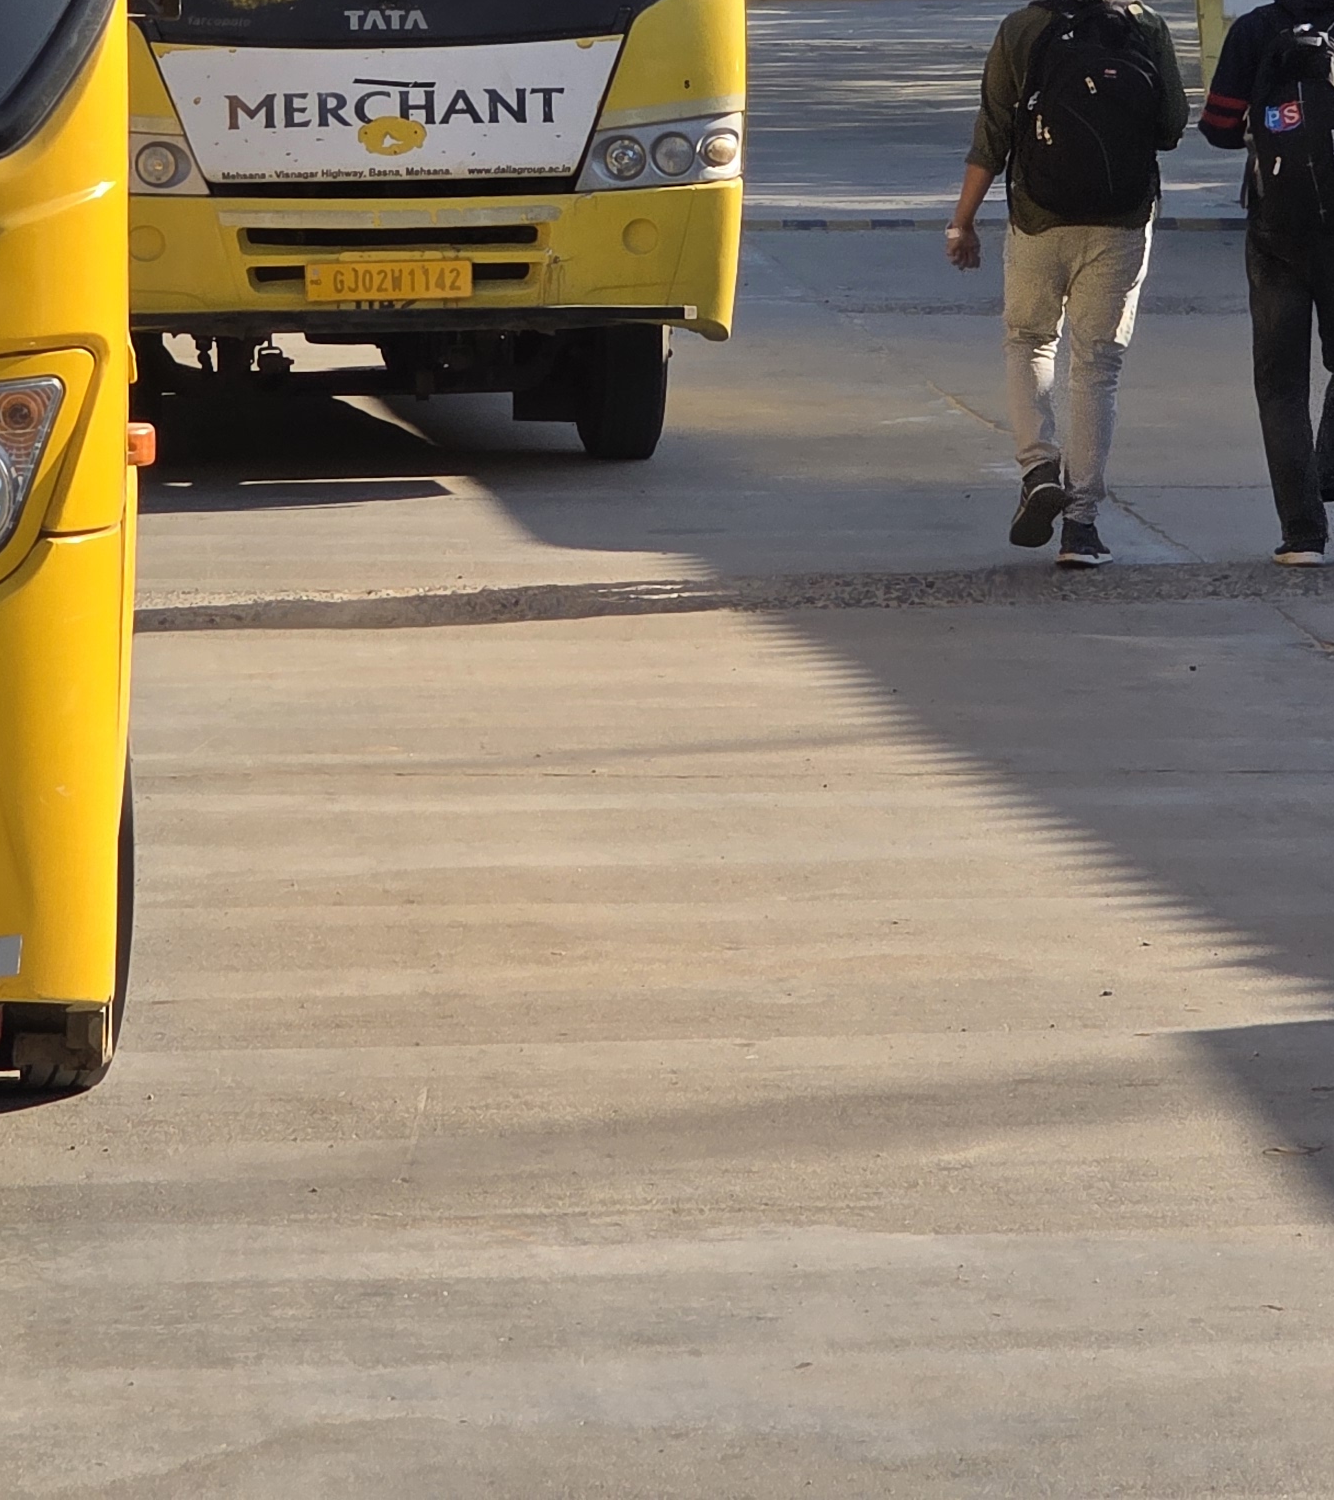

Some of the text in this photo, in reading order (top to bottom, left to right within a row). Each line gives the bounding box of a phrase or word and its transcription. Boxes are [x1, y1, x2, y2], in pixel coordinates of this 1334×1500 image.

[344, 9, 429, 31] TATA
[224, 87, 566, 131] MERCHANT
[221, 171, 267, 181] Mehsana
[274, 169, 319, 181] Visnagar
[333, 267, 462, 294] GJ02W1142
